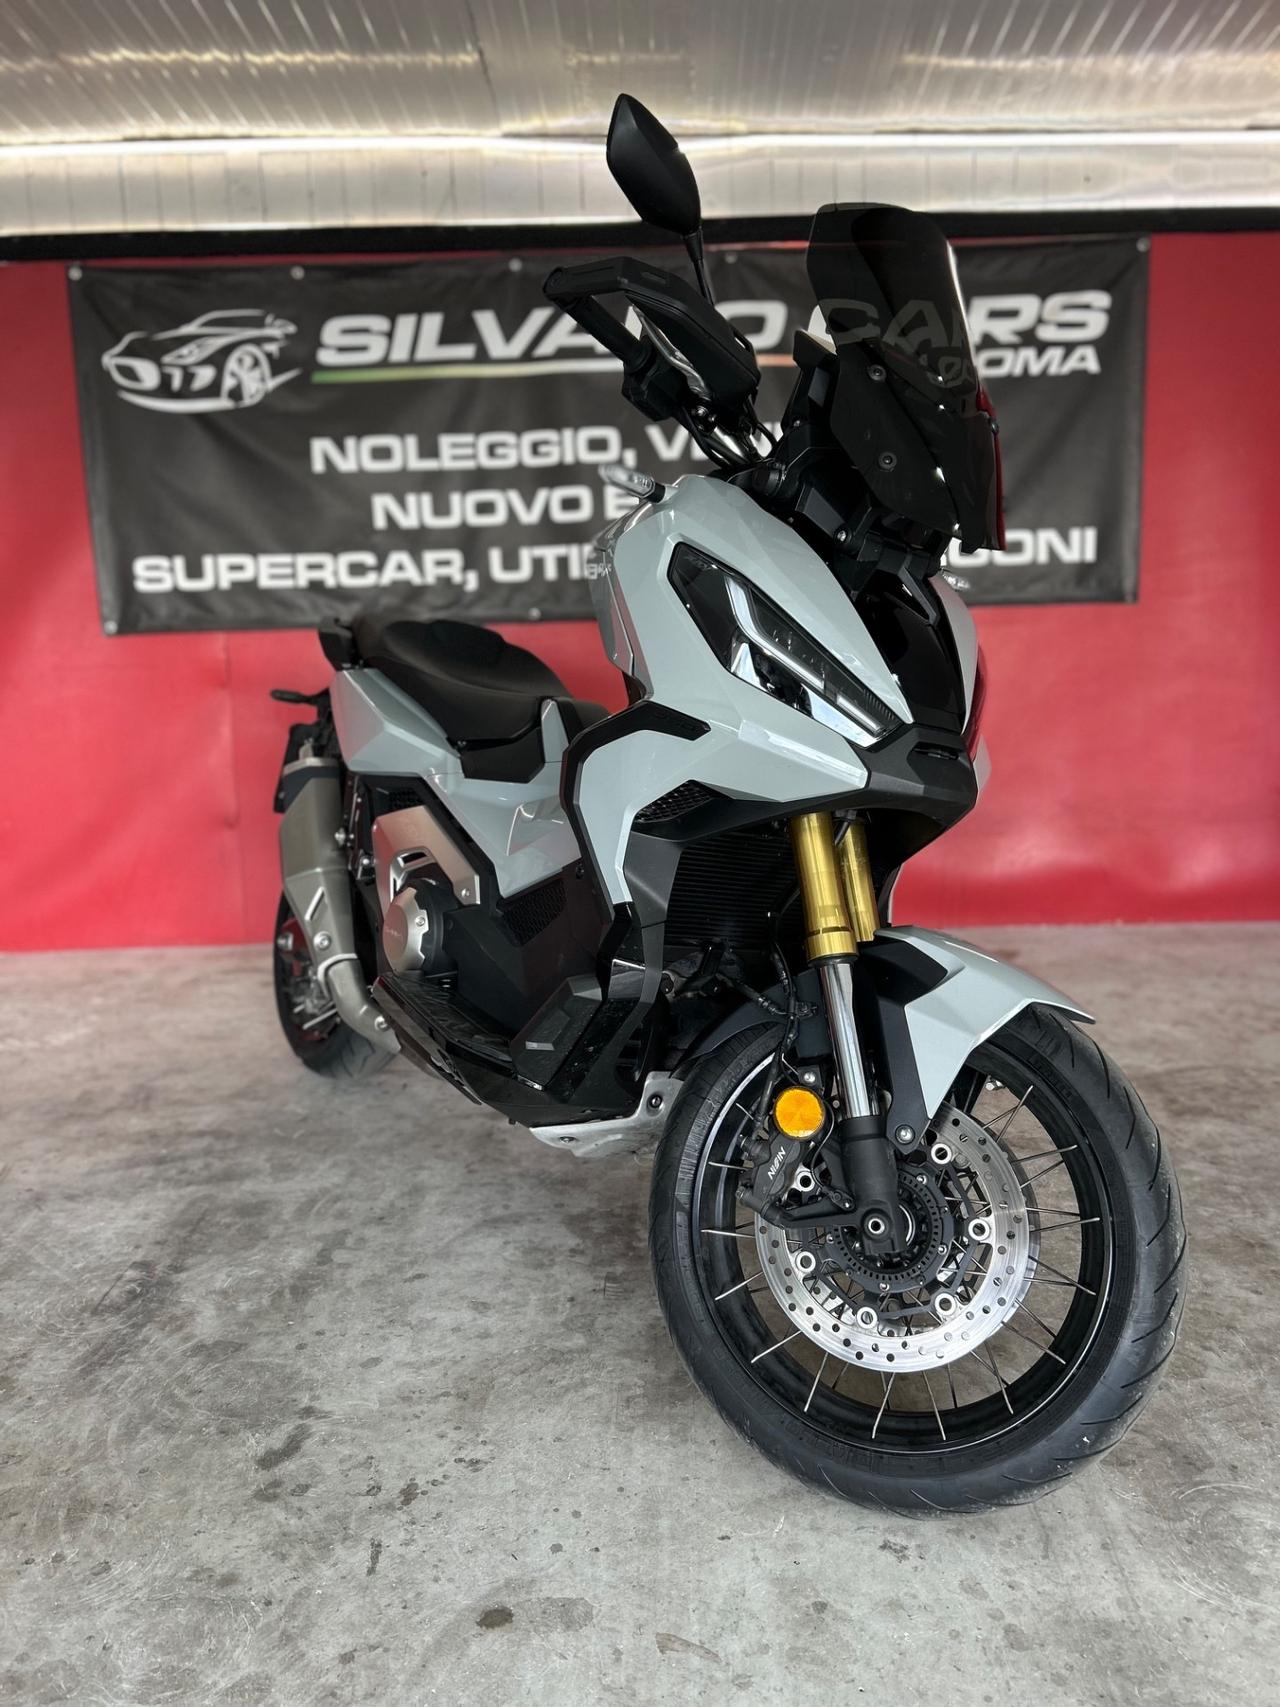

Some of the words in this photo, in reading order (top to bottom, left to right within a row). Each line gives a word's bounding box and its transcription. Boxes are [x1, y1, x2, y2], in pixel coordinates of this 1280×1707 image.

[316, 300, 788, 367] SILVAO
[310, 425, 637, 474] NOLEGGIO,
[371, 485, 593, 530] NUOVO
[132, 549, 479, 593] SUPERCAR,
